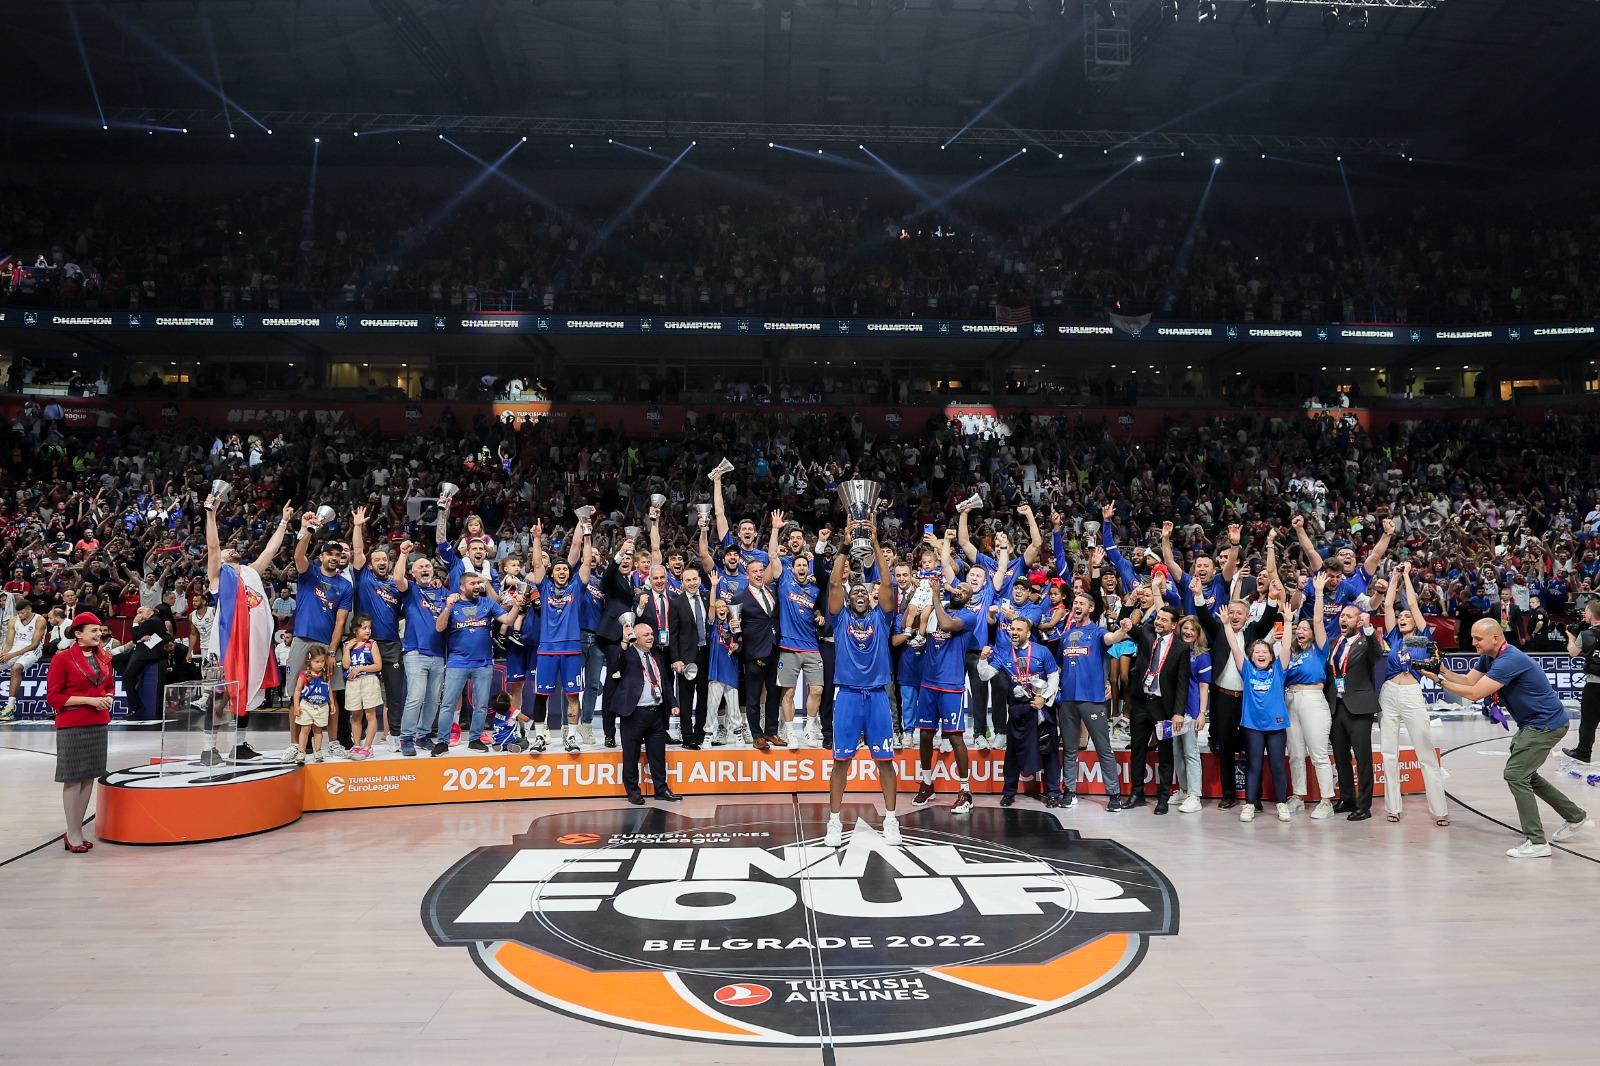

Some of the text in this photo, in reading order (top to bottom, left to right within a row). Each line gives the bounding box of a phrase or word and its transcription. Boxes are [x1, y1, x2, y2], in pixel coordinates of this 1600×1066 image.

[52, 316, 113, 325] CHAMPION
[155, 317, 214, 326] CHAMPION
[262, 318, 320, 326] CHAMPION
[360, 319, 419, 327] CHAMPION
[461, 319, 519, 328] CHAMPION
[566, 320, 625, 329] CHAMPION
[664, 321, 722, 330] CHAMPION
[763, 322, 821, 331] CHAMPION
[866, 323, 923, 332] CHAMPION
[1058, 326, 1114, 335] CHAMPION
[1157, 328, 1213, 336] CHAMPION
[1248, 329, 1303, 337] CHAMPION
[1341, 330, 1394, 338] CHAMPION
[1436, 331, 1493, 339] CHAMPION
[1533, 327, 1595, 336] CHAMPION
[951, 712, 957, 725] 2
[348, 774, 417, 785] TURKISH AIRLINES
[442, 765, 552, 791] 2021-22
[688, 759, 815, 783] AIRLINES
[348, 783, 400, 793] EuroLeague
[607, 837, 731, 845] EuroLeague
[492, 820, 1056, 882] FINAL
[452, 875, 1152, 923] FOUR
[642, 934, 985, 952] BELGRADE 2022
[785, 977, 924, 992] TURKISH
[785, 989, 930, 1003] AIRLINES
